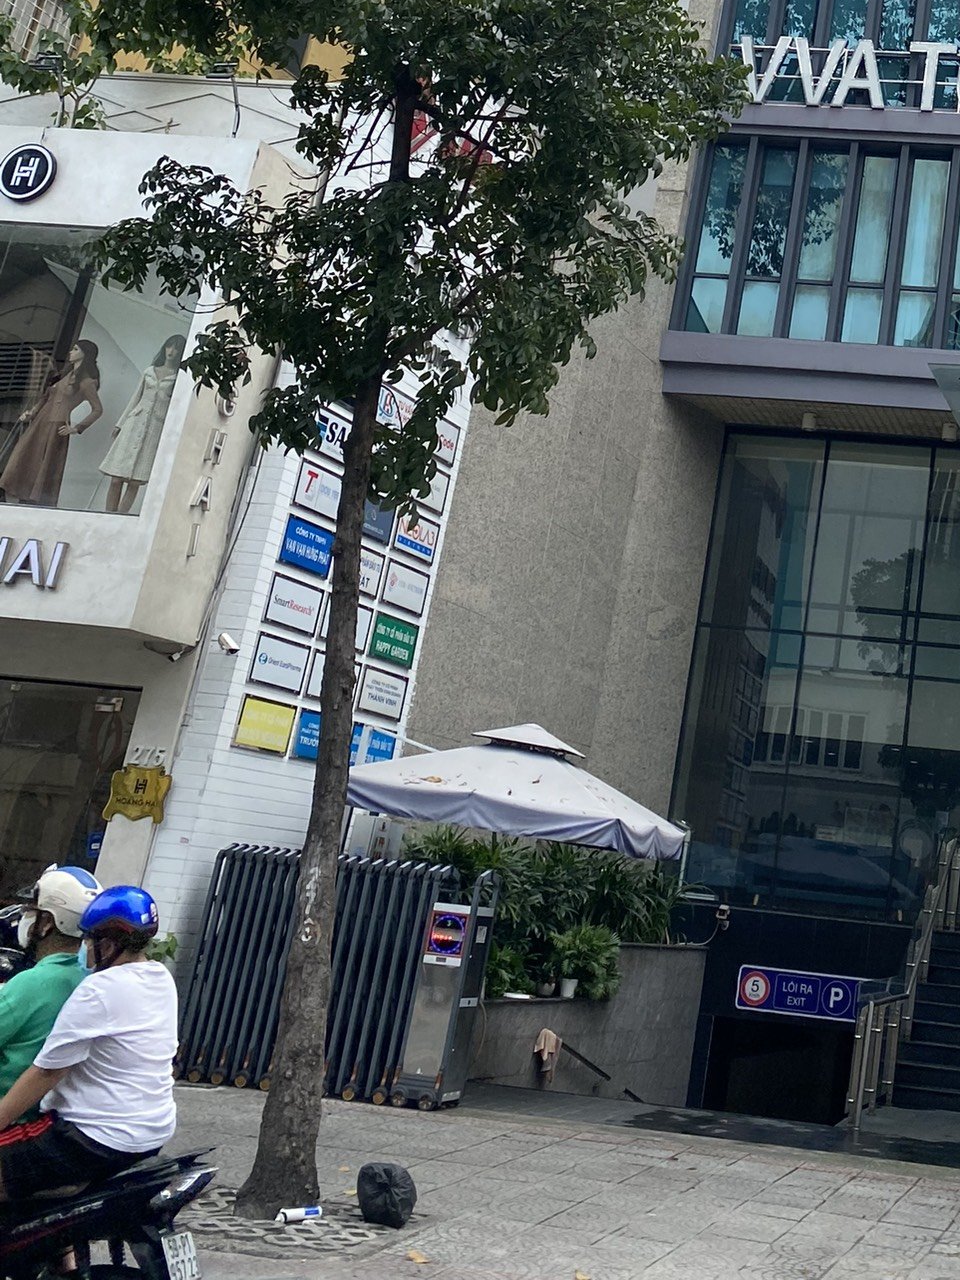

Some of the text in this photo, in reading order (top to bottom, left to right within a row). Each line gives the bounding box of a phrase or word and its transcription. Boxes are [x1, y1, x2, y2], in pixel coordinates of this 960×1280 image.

[741, 35, 885, 110] VVA
[10, 156, 40, 187] H
[127, 747, 166, 767] 275
[751, 979, 760, 993] 5
[800, 983, 813, 995] RA
[787, 995, 806, 1007] EXIT
[829, 987, 844, 1008] P
